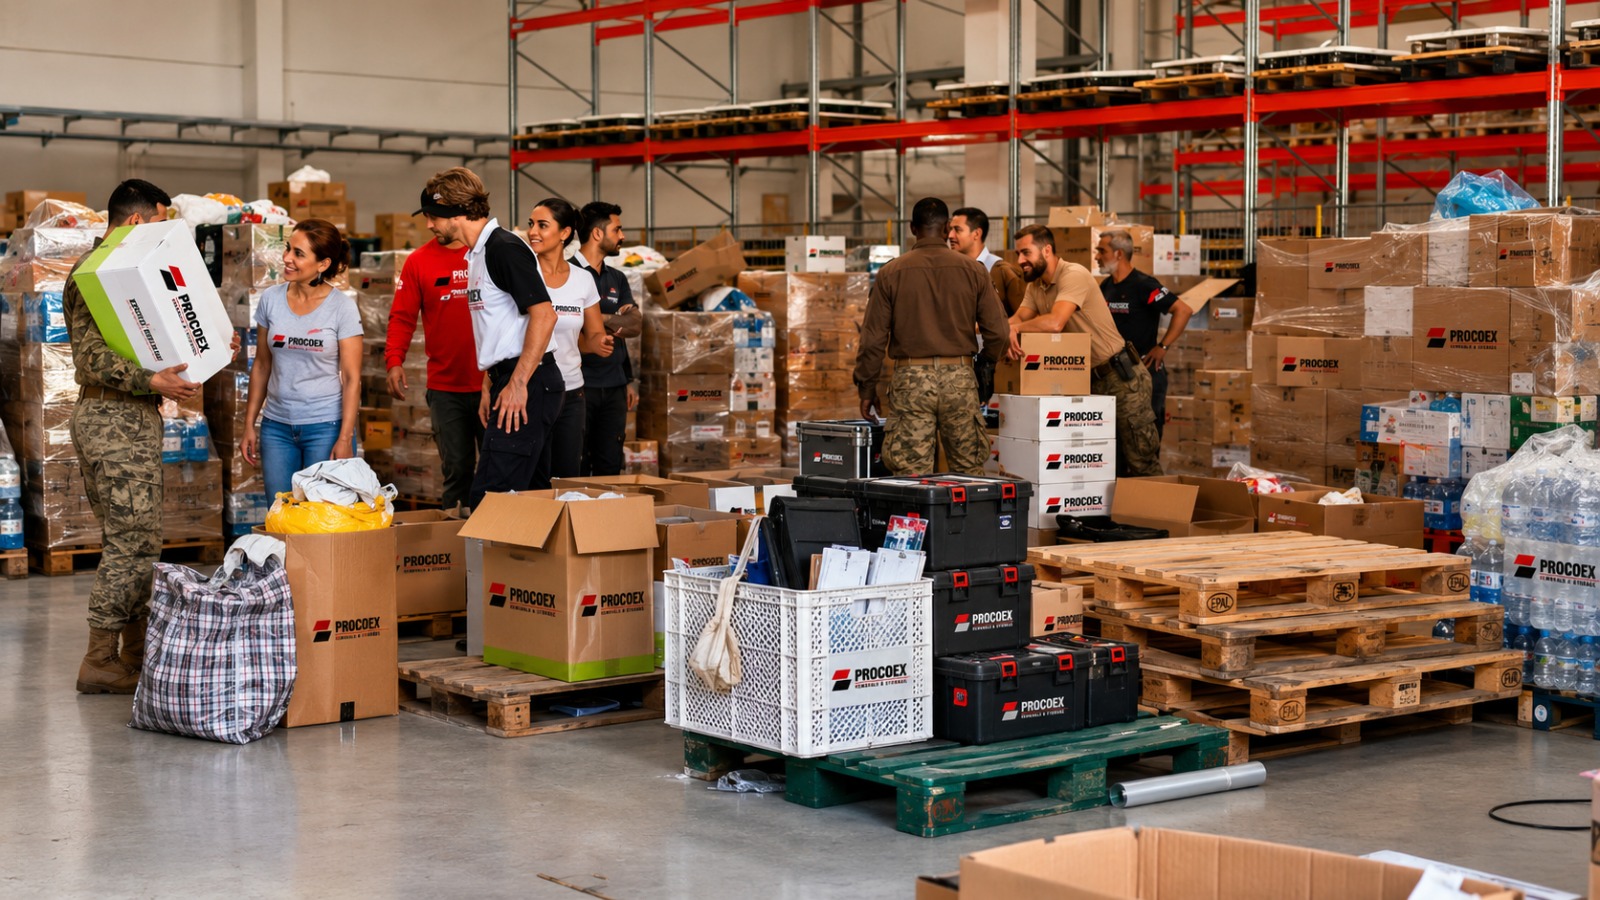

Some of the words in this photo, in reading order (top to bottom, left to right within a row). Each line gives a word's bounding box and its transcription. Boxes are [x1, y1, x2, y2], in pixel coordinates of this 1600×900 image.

[452, 270, 469, 280] PRO
[178, 293, 210, 354] PROCOEX
[288, 336, 324, 348] PROCOEX
[1450, 330, 1498, 343] PROCOEX
[1043, 356, 1085, 366] PROCOEX
[1300, 358, 1339, 369] PROCOEX
[1064, 411, 1103, 422] PROCOEX
[1064, 453, 1103, 464] PROCOEX
[1064, 496, 1103, 507] PROCOEX
[403, 553, 451, 567] PROCOEX
[1540, 559, 1596, 579] PROCOEX
[510, 587, 556, 608] PROCOEX
[601, 591, 645, 608] PROCOEX
[1210, 596, 1230, 610] EPAL
[972, 610, 1013, 625] PROCOEX
[335, 617, 381, 633] PROCOEX
[855, 663, 907, 682] PROCOEX
[1021, 696, 1065, 712] PROCOEX
